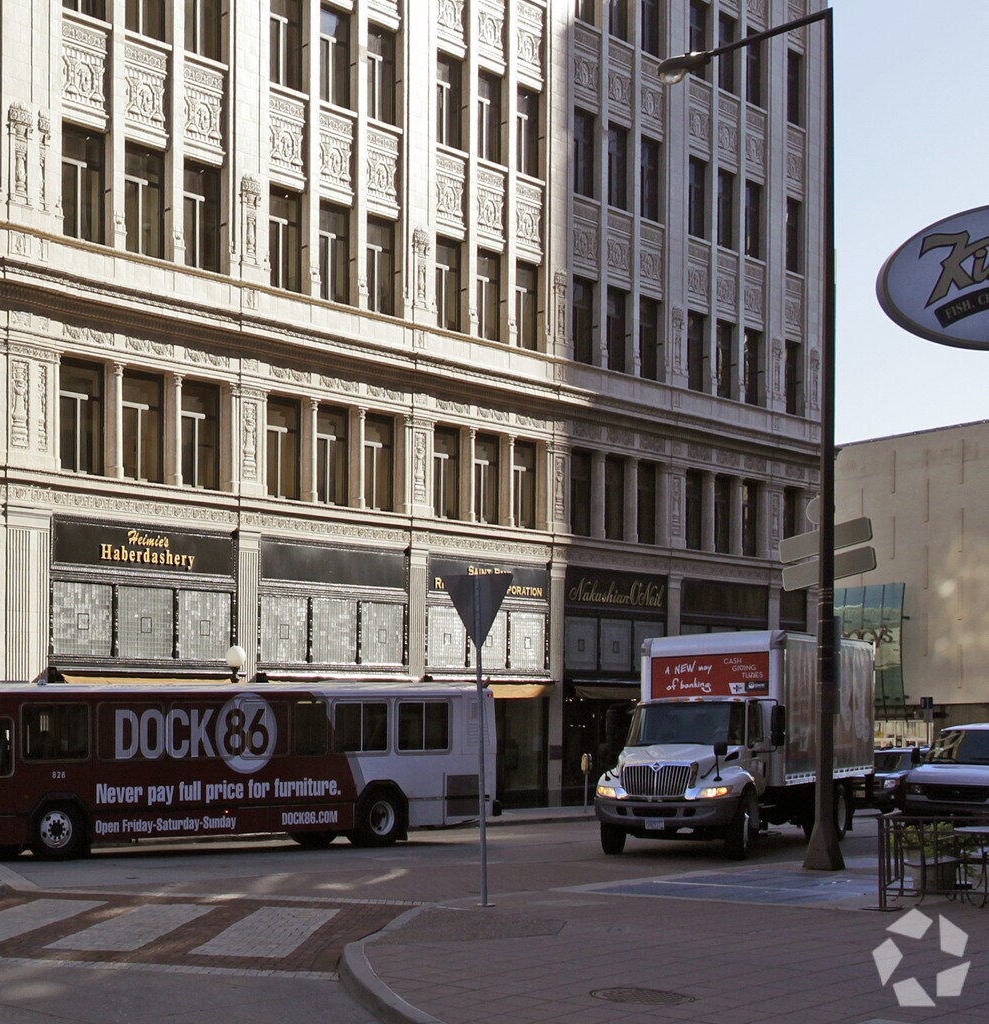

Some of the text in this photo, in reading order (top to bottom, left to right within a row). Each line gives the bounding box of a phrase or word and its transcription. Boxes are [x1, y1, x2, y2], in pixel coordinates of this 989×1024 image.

[918, 230, 989, 309] Ki
[127, 530, 169, 549] Heimie's
[100, 543, 195, 570] Haberdashery
[506, 585, 544, 597] PORATION
[674, 660, 696, 675] NEW
[723, 657, 743, 665] CASH
[666, 677, 712, 693] of banking
[96, 777, 341, 806] Never pay full price for furniture.
[95, 816, 236, 835] Open Friday-Saturday-Sunday
[281, 811, 338, 825] DOCK86.COM
